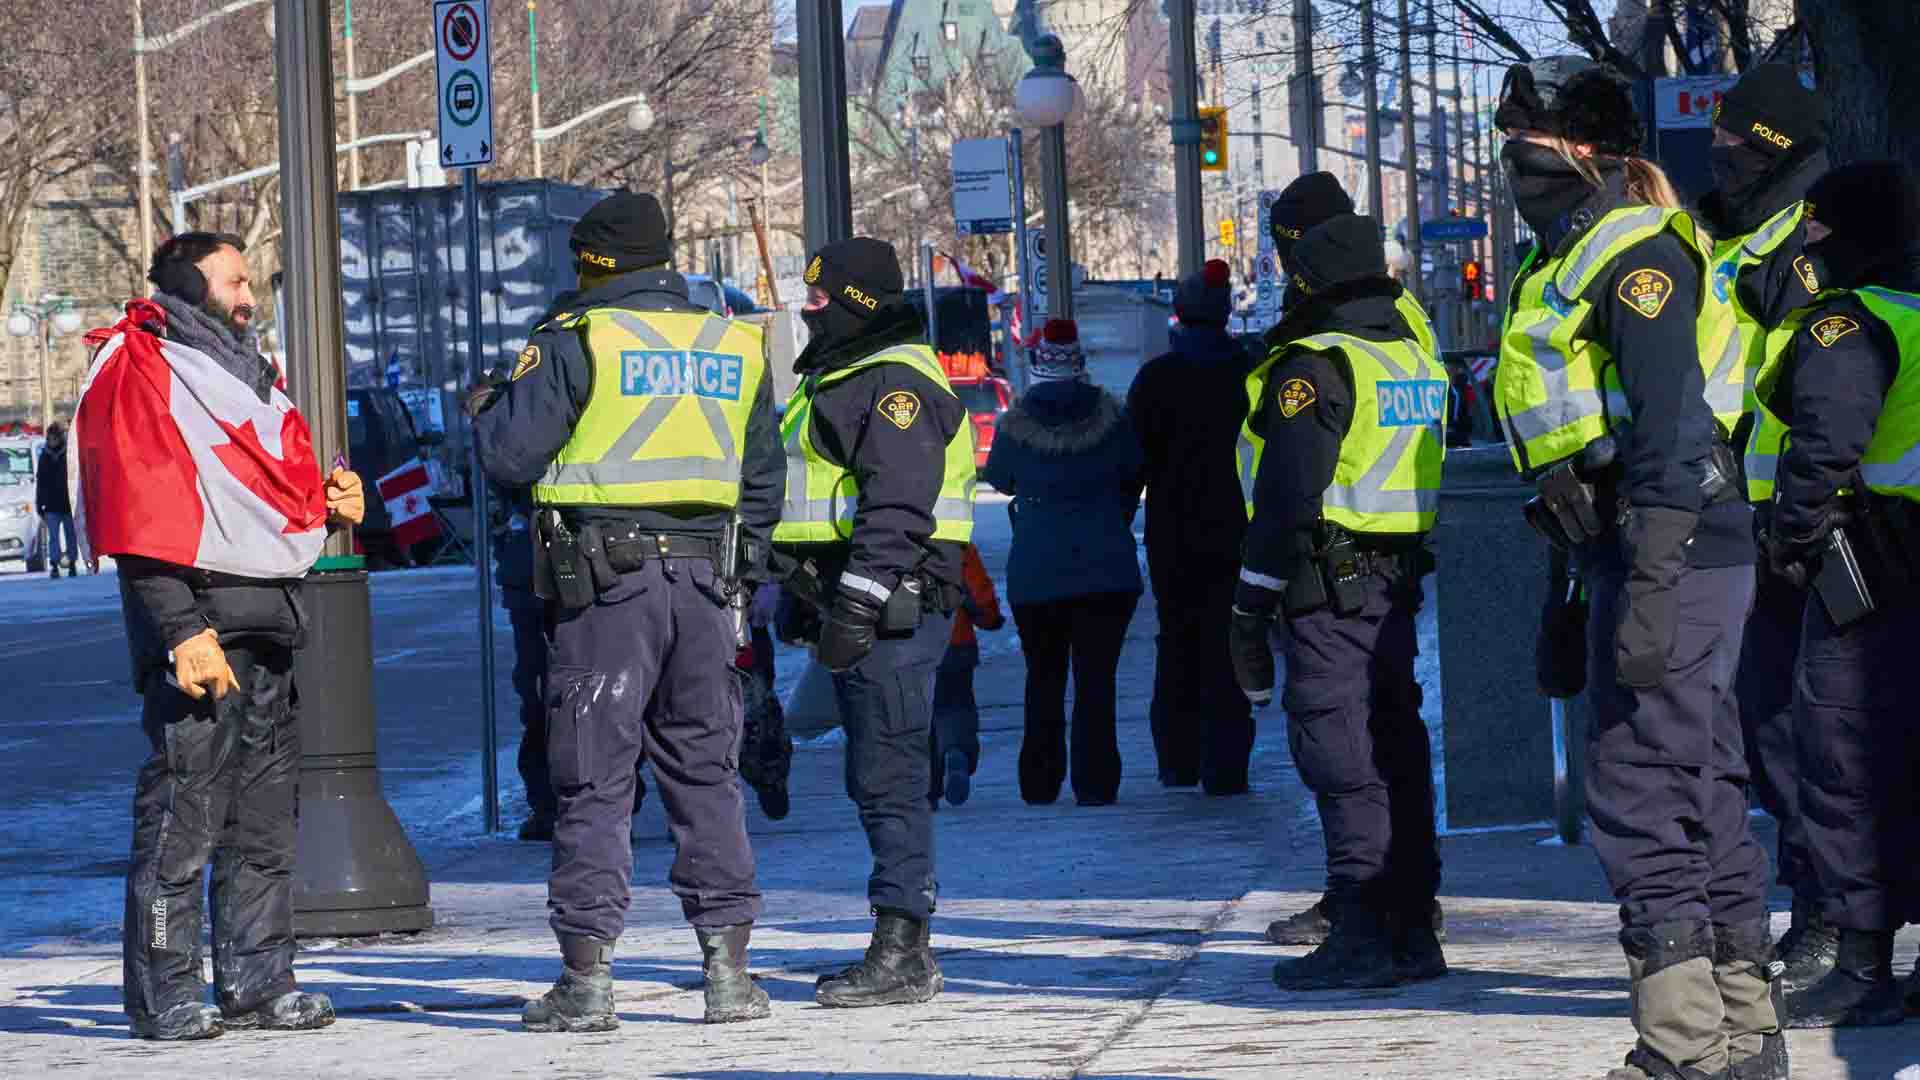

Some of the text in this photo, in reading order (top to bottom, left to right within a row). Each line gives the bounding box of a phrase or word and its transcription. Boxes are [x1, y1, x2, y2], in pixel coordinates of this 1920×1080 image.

[1752, 123, 1793, 149] POLICE
[624, 355, 740, 393] POLICE
[1378, 385, 1444, 422] POLIC
[152, 899, 167, 949] kamik
